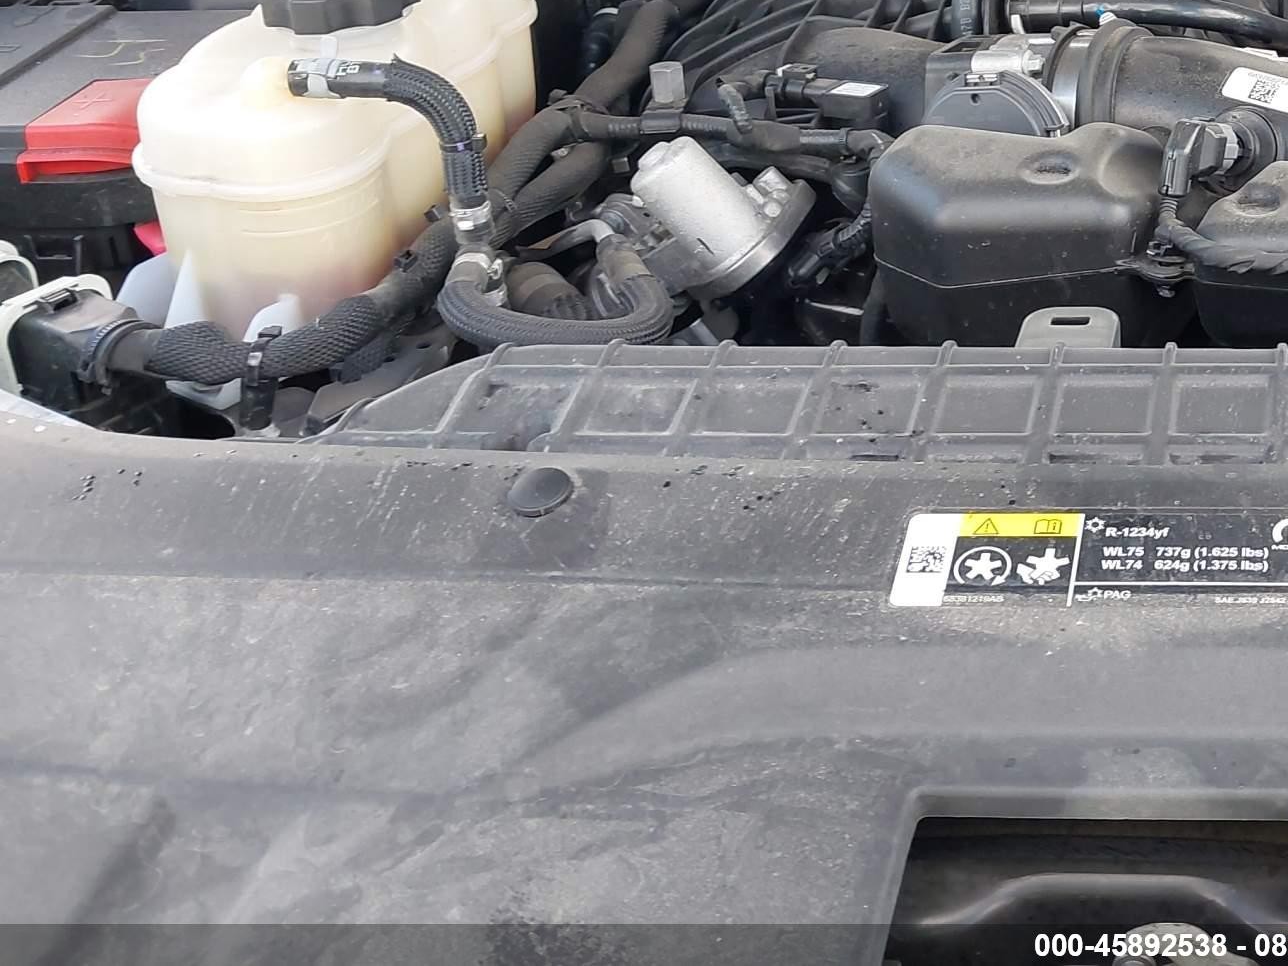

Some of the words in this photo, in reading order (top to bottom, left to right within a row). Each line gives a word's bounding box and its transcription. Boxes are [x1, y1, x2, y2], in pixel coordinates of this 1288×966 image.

[1105, 527, 1170, 539] R-1234yf
[1103, 547, 1145, 557] WL75
[1156, 547, 1191, 559] 737g
[1194, 546, 1239, 559] (1.625
[1241, 546, 1269, 559] lbs)
[1101, 560, 1143, 570] WL74
[1154, 560, 1190, 572] 624g
[1193, 559, 1238, 572] (1.375
[1240, 559, 1269, 572] lbs)
[1104, 589, 1132, 600] PAG
